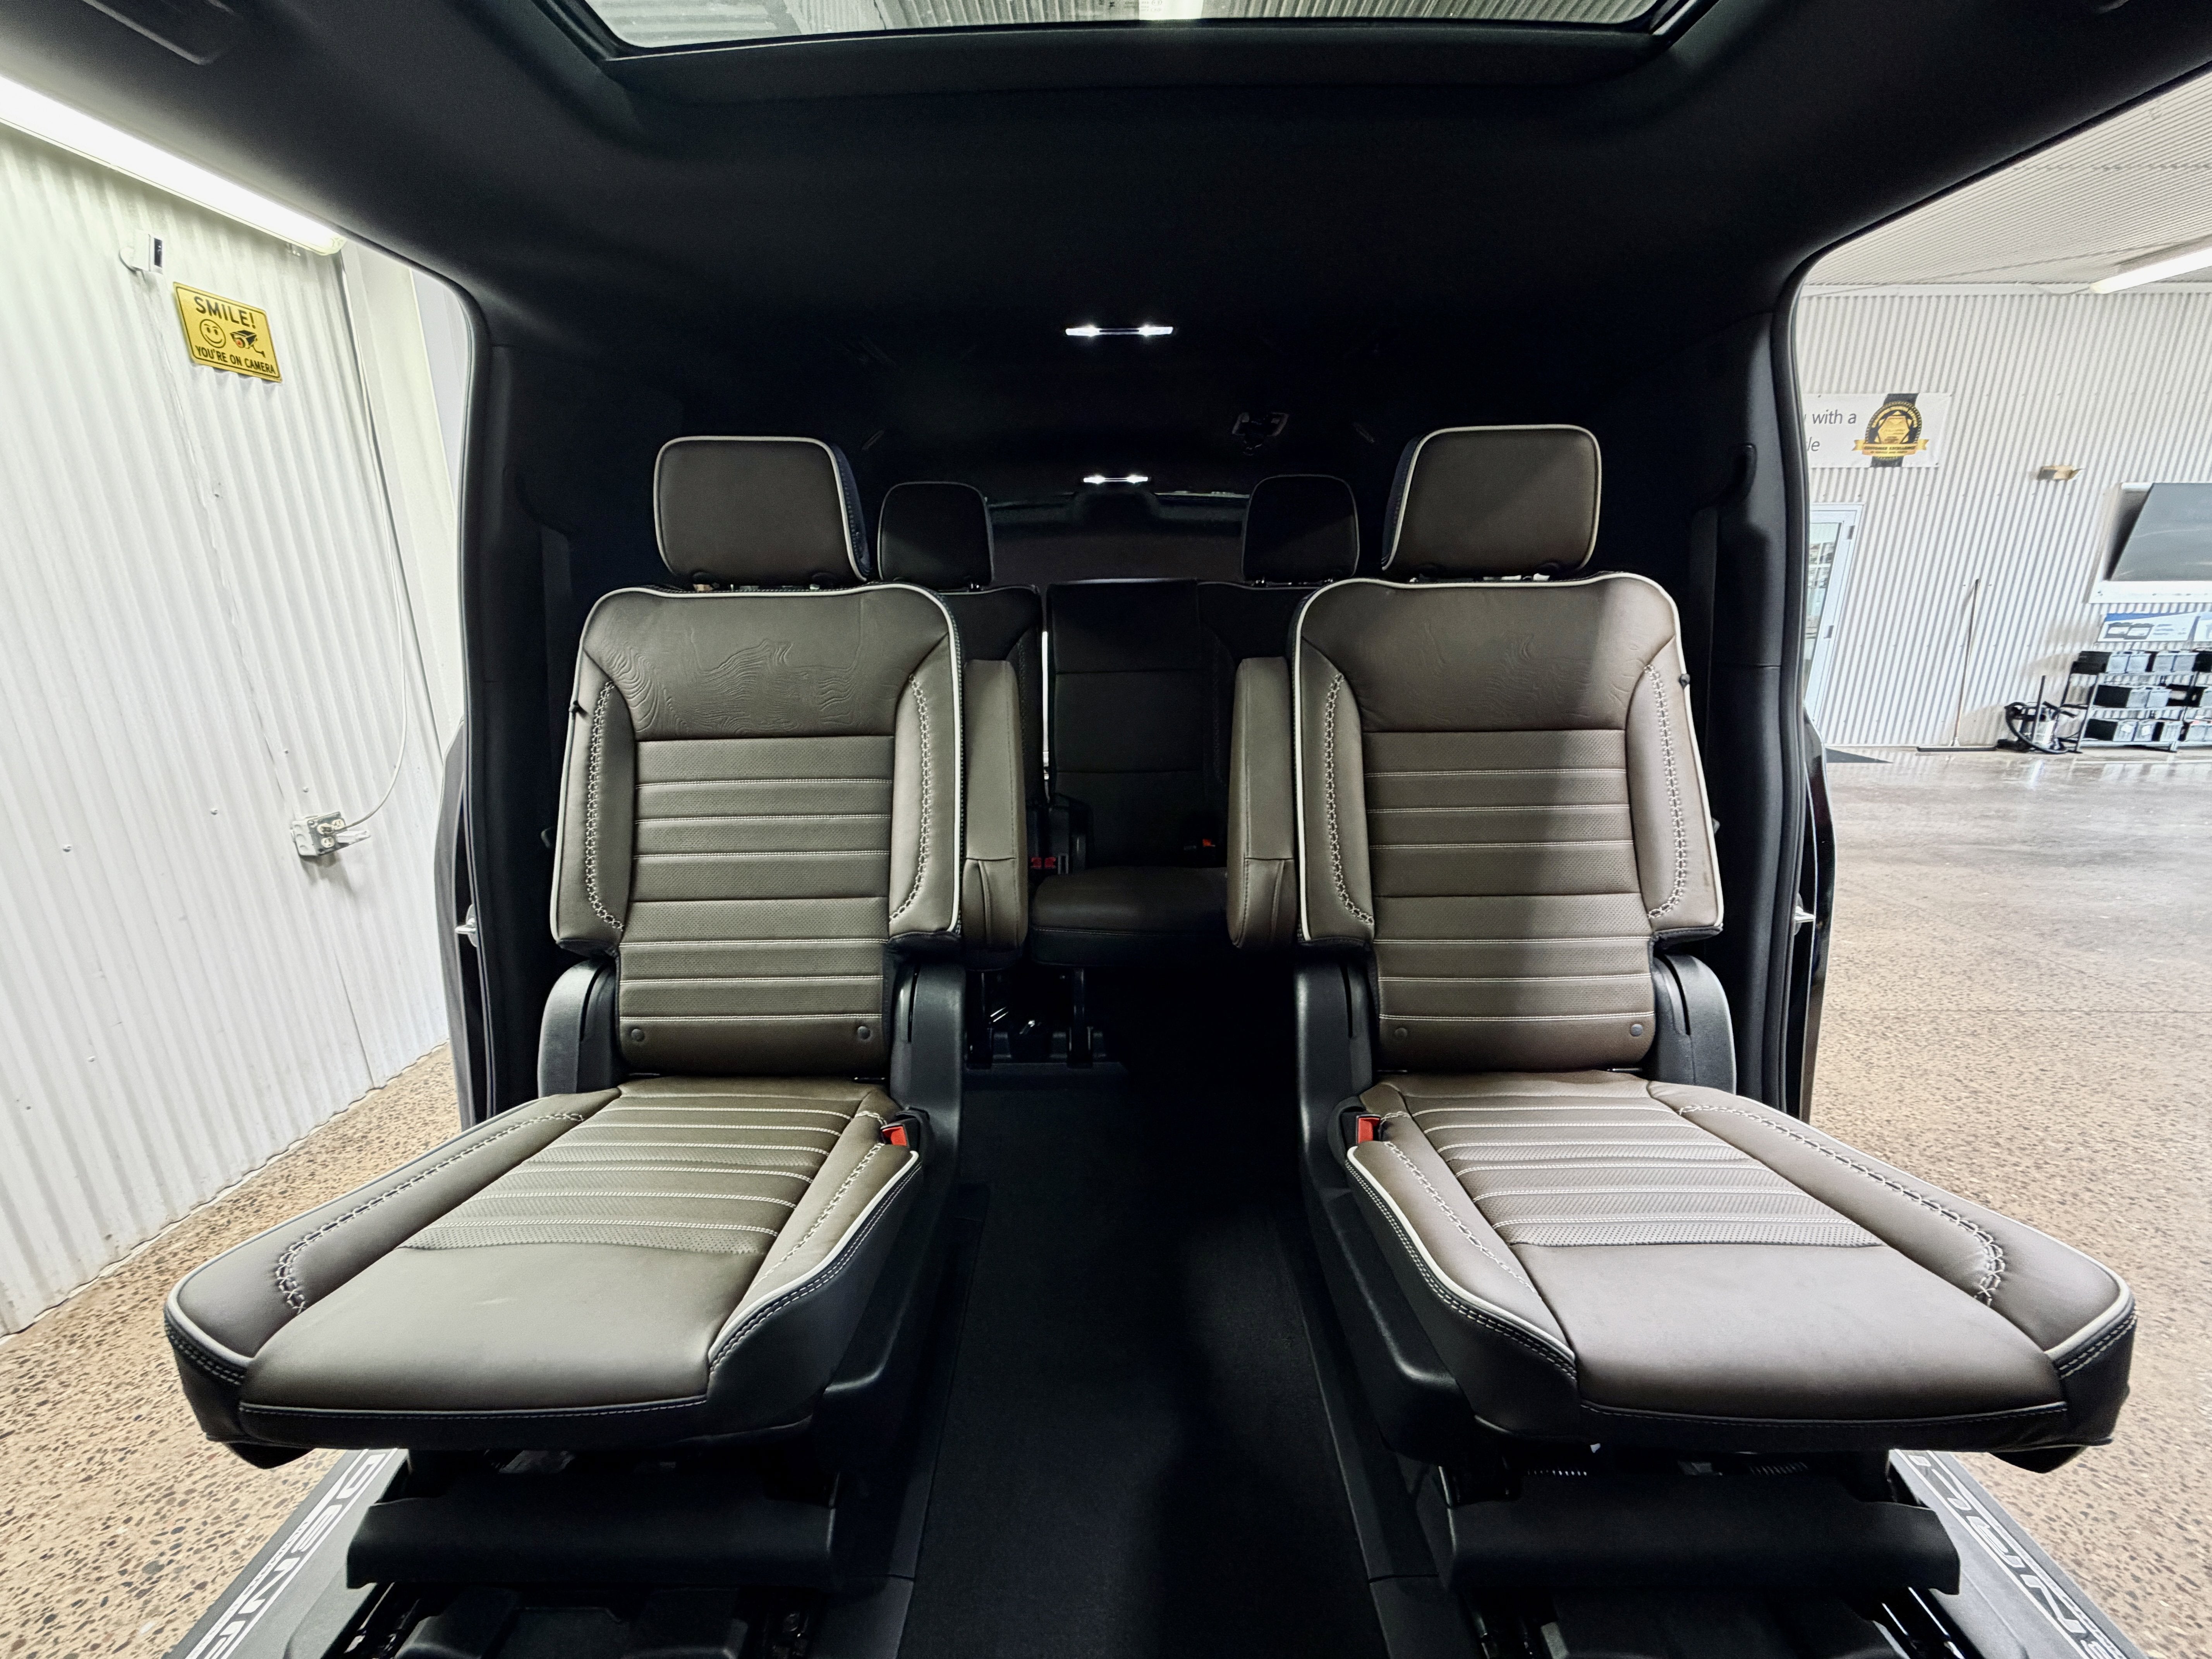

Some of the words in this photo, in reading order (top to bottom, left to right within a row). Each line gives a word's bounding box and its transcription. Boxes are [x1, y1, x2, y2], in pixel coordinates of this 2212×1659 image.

[194, 296, 256, 329] SMILE!
[195, 345, 228, 363] YOU'RE
[230, 354, 242, 366] ON
[244, 358, 276, 374] CAMERA
[1812, 409, 1843, 424] with
[1848, 413, 1856, 424] a
[1806, 437, 1820, 452] le
[205, 1453, 386, 1659] DENA
[1909, 1455, 2113, 1659] NALI
